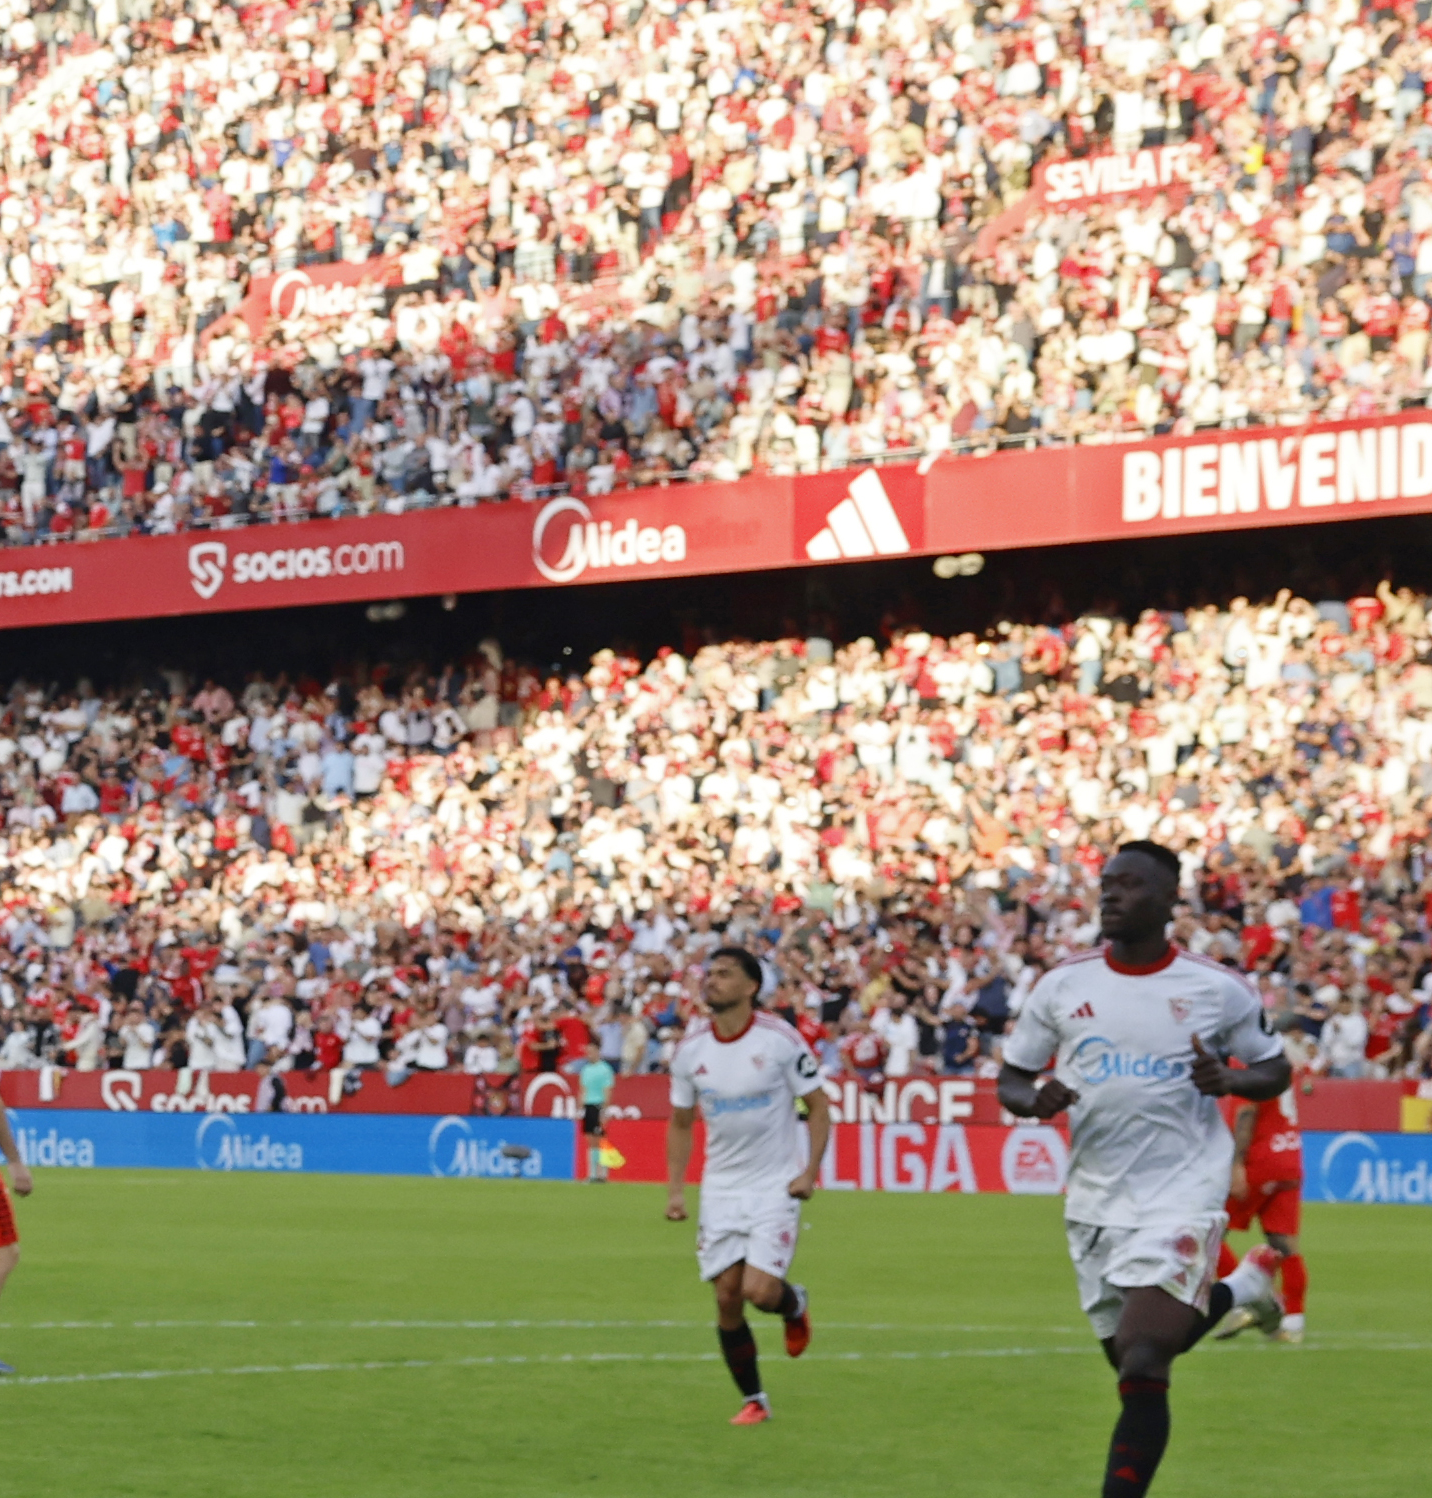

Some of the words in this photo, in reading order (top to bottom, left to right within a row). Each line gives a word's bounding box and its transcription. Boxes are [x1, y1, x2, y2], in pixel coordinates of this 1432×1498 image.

[1045, 149, 1158, 203] SEVILLA
[555, 518, 687, 576] Midea
[217, 1133, 303, 1171] Midea
